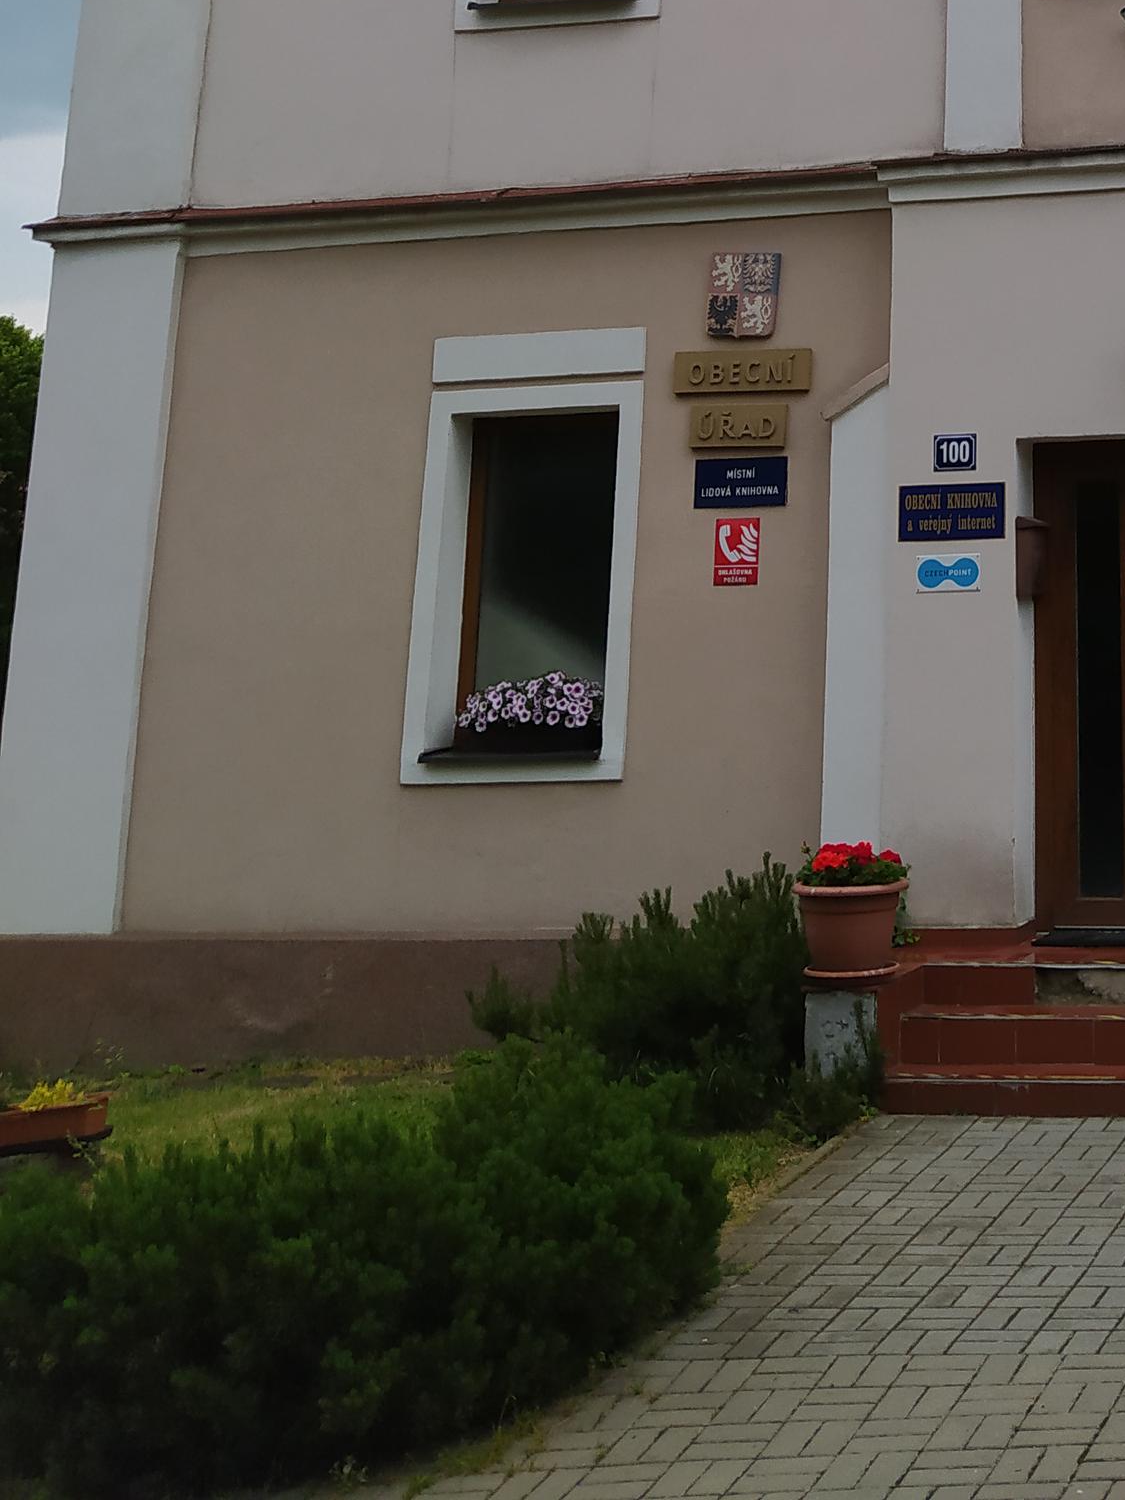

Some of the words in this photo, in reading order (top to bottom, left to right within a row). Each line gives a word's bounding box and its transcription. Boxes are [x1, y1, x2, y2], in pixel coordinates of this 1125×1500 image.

[688, 354, 796, 385] OBECNÍ
[698, 412, 776, 441] ÚŘAD
[939, 440, 970, 463] 100
[726, 467, 756, 479] MÍSTNÍ
[701, 485, 732, 498] LIDOVÁ
[735, 485, 779, 496] KNIHOVNA
[905, 488, 941, 510] OBECNÍ
[947, 492, 997, 509] KNIHOVNA
[907, 519, 913, 532] a
[919, 514, 953, 535] veřejný
[958, 514, 996, 530] internet
